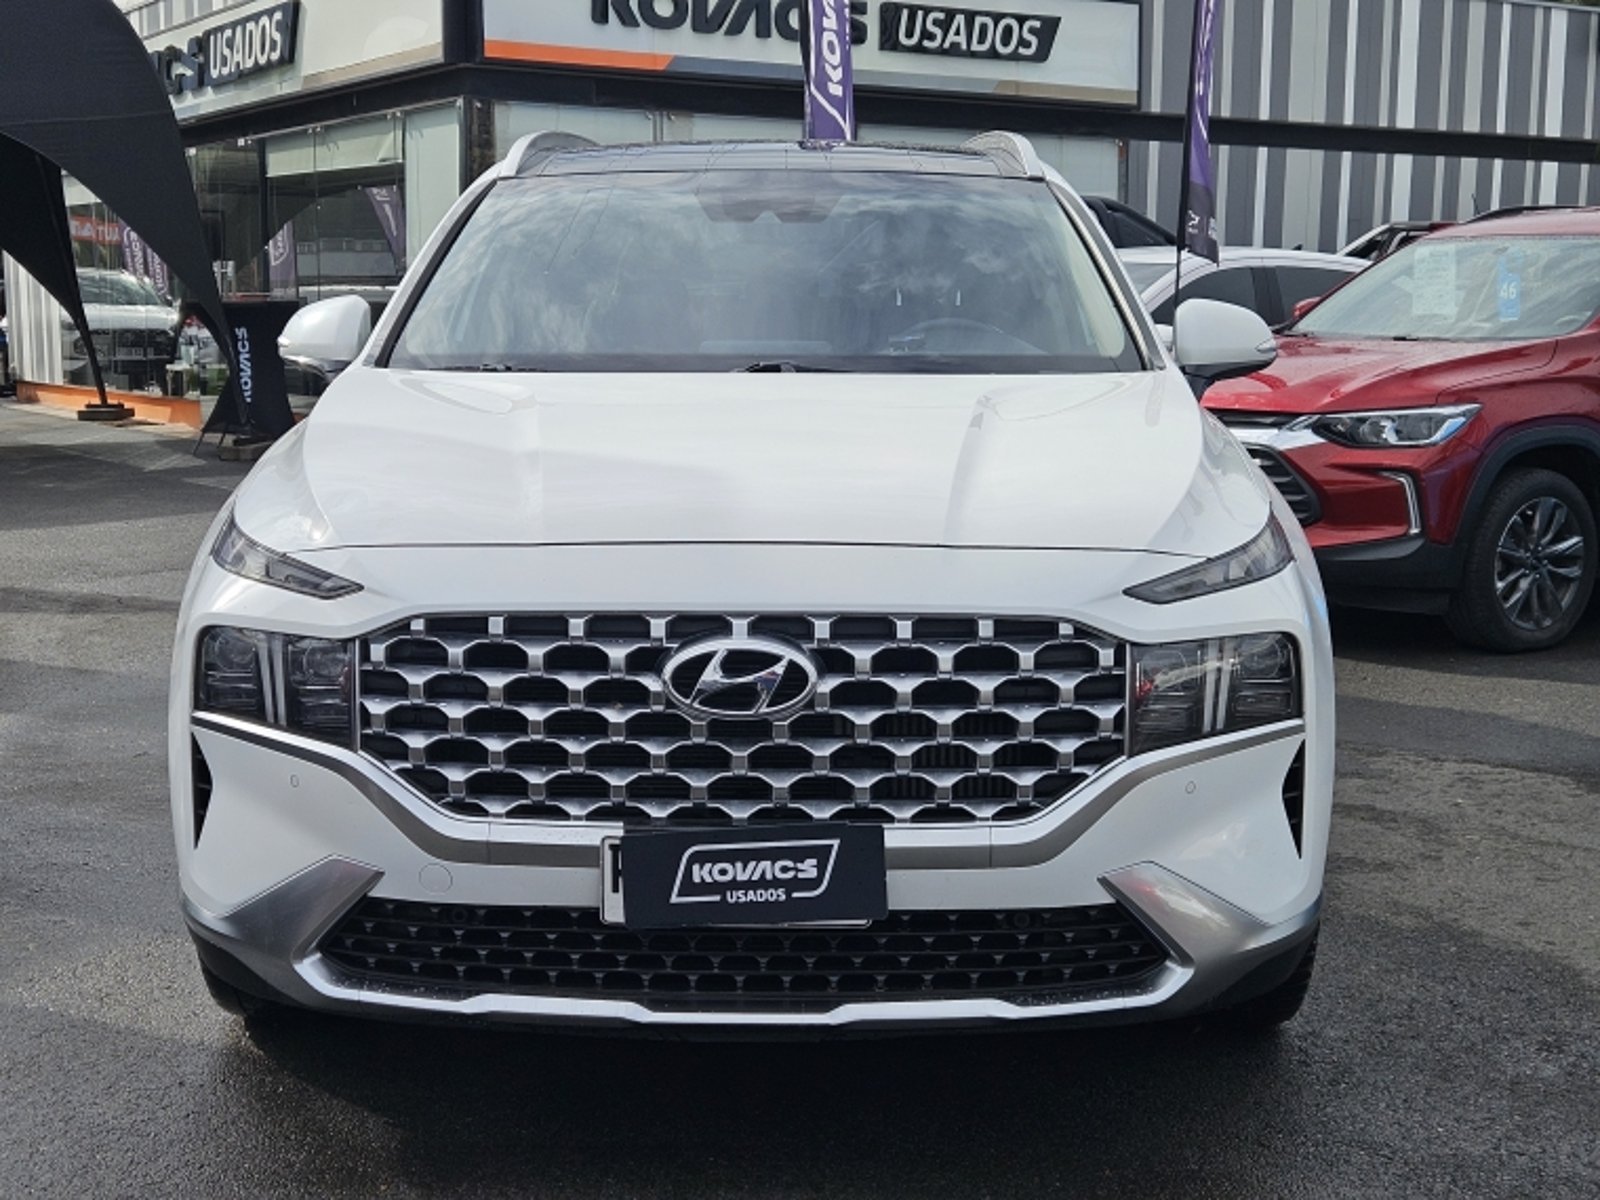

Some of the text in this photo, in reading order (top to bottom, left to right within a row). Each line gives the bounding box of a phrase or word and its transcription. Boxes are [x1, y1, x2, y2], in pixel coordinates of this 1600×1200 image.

[898, 8, 1042, 56] USADOS
[209, 11, 283, 79] USADOS
[1500, 281, 1517, 299] 46
[692, 858, 818, 883] KOVACS
[726, 888, 786, 904] USADOS
